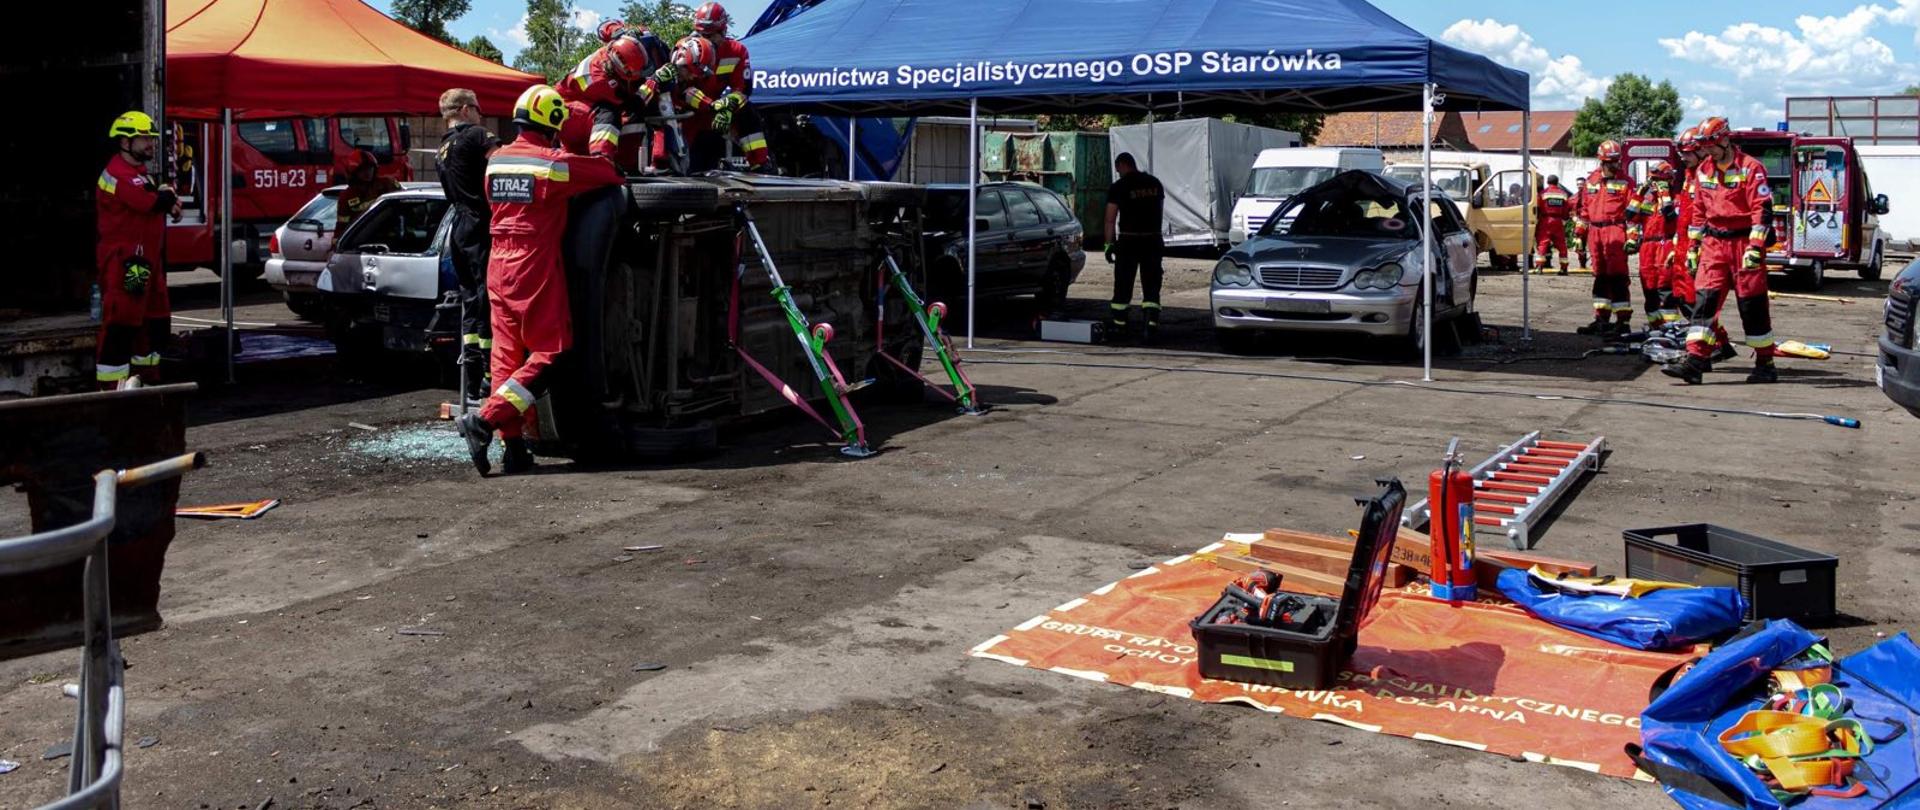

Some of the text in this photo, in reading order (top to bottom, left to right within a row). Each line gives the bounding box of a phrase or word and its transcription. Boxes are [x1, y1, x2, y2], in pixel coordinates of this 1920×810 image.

[752, 48, 1342, 89] Ratownictwa Specjalistycznego OSP Starówka
[254, 169, 278, 188] 551
[288, 169, 306, 187] 23
[1040, 620, 1122, 641] GRUPA
